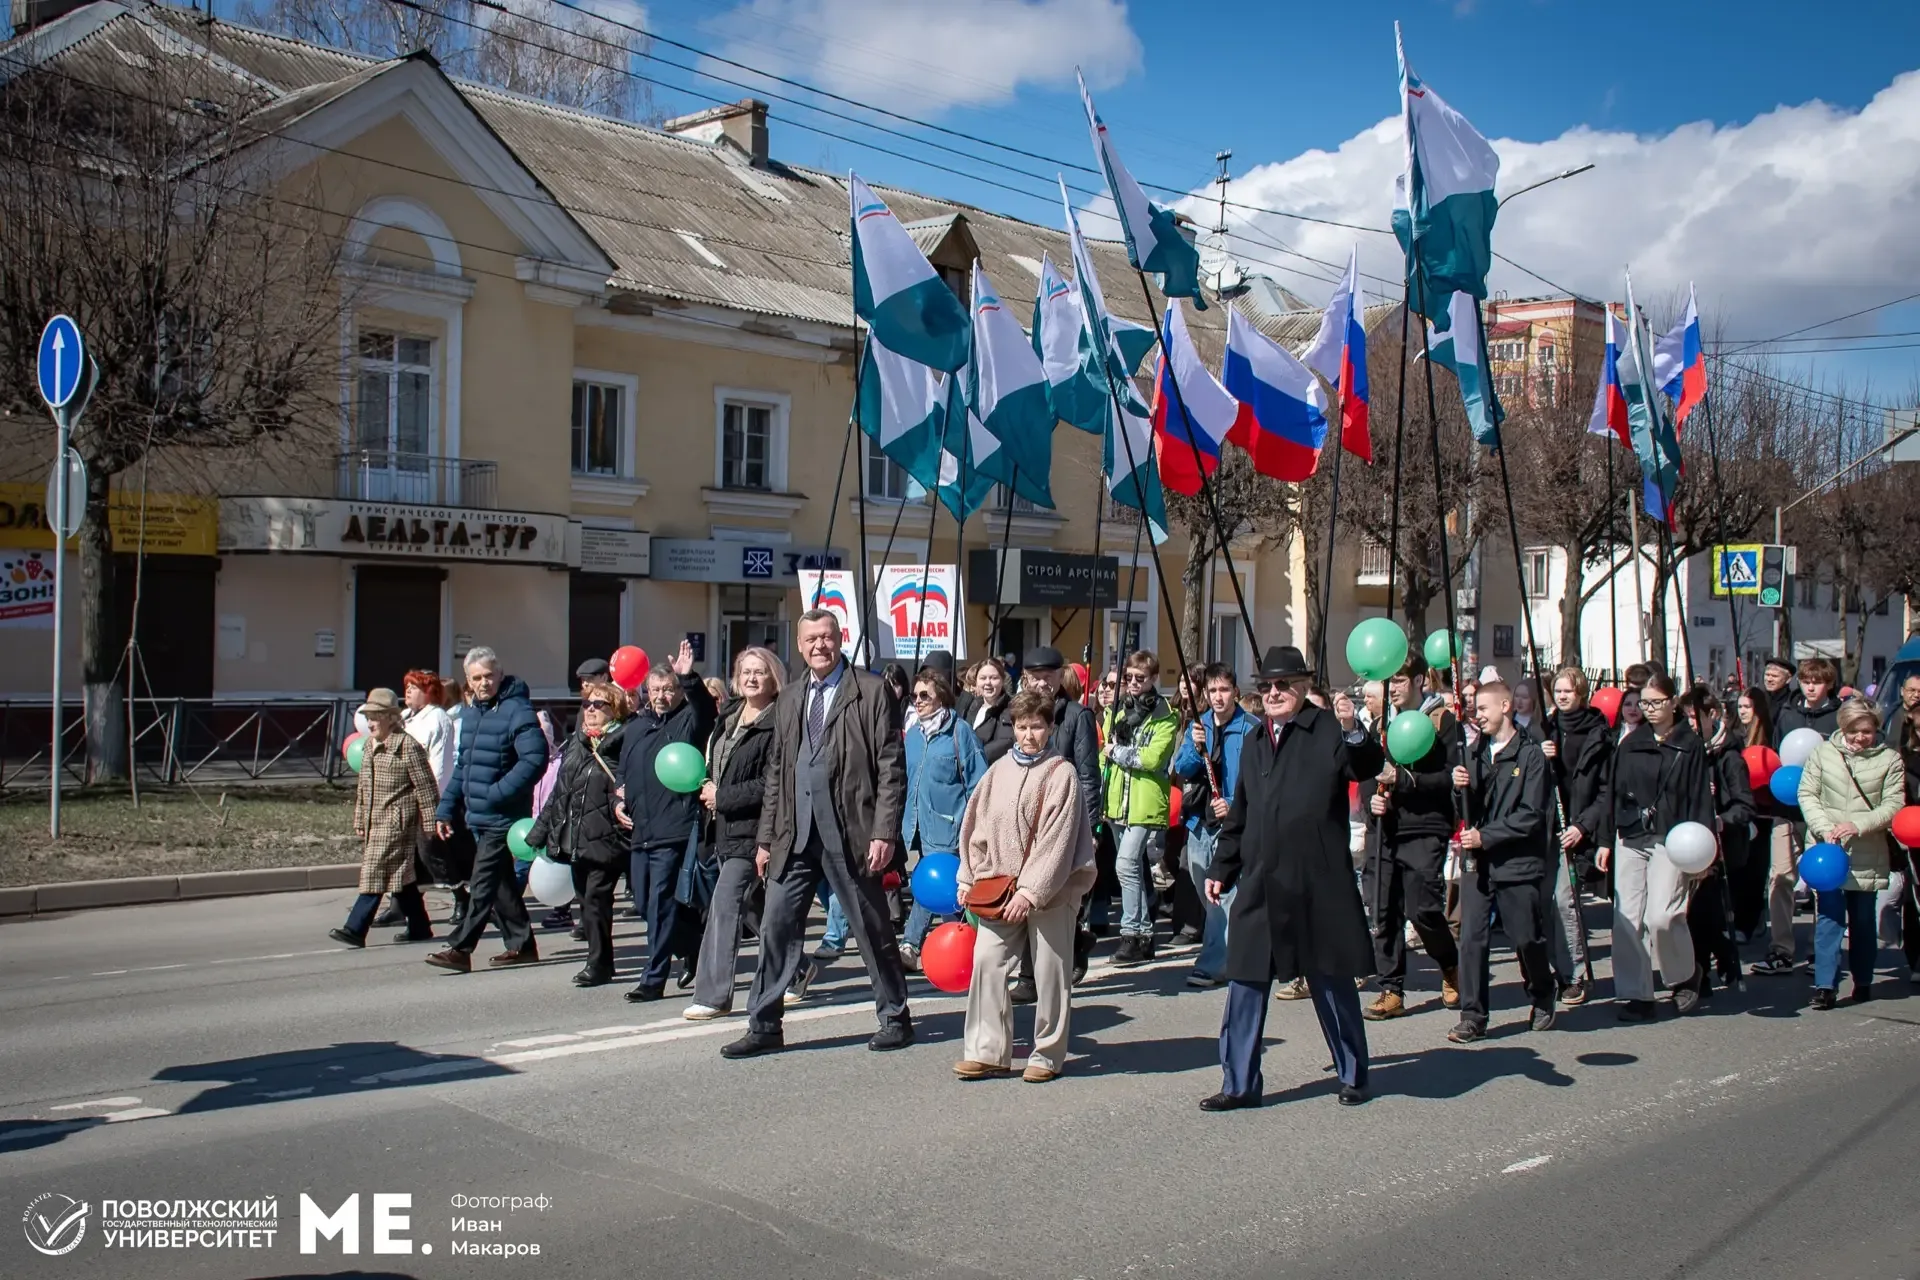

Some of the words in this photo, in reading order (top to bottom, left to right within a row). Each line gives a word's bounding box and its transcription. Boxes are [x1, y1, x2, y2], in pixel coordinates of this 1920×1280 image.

[349, 505, 453, 519] ТУРИСТИЧЕСКОЕ
[461, 513, 527, 524] АГЕНТСТВО
[341, 515, 538, 550] ДЕЛЬТА-ТУР
[370, 543, 423, 553] ТУРИЗМ
[1026, 565, 1062, 577] СТРОЙ
[890, 603, 909, 637] 1
[911, 622, 949, 638] МАЯ
